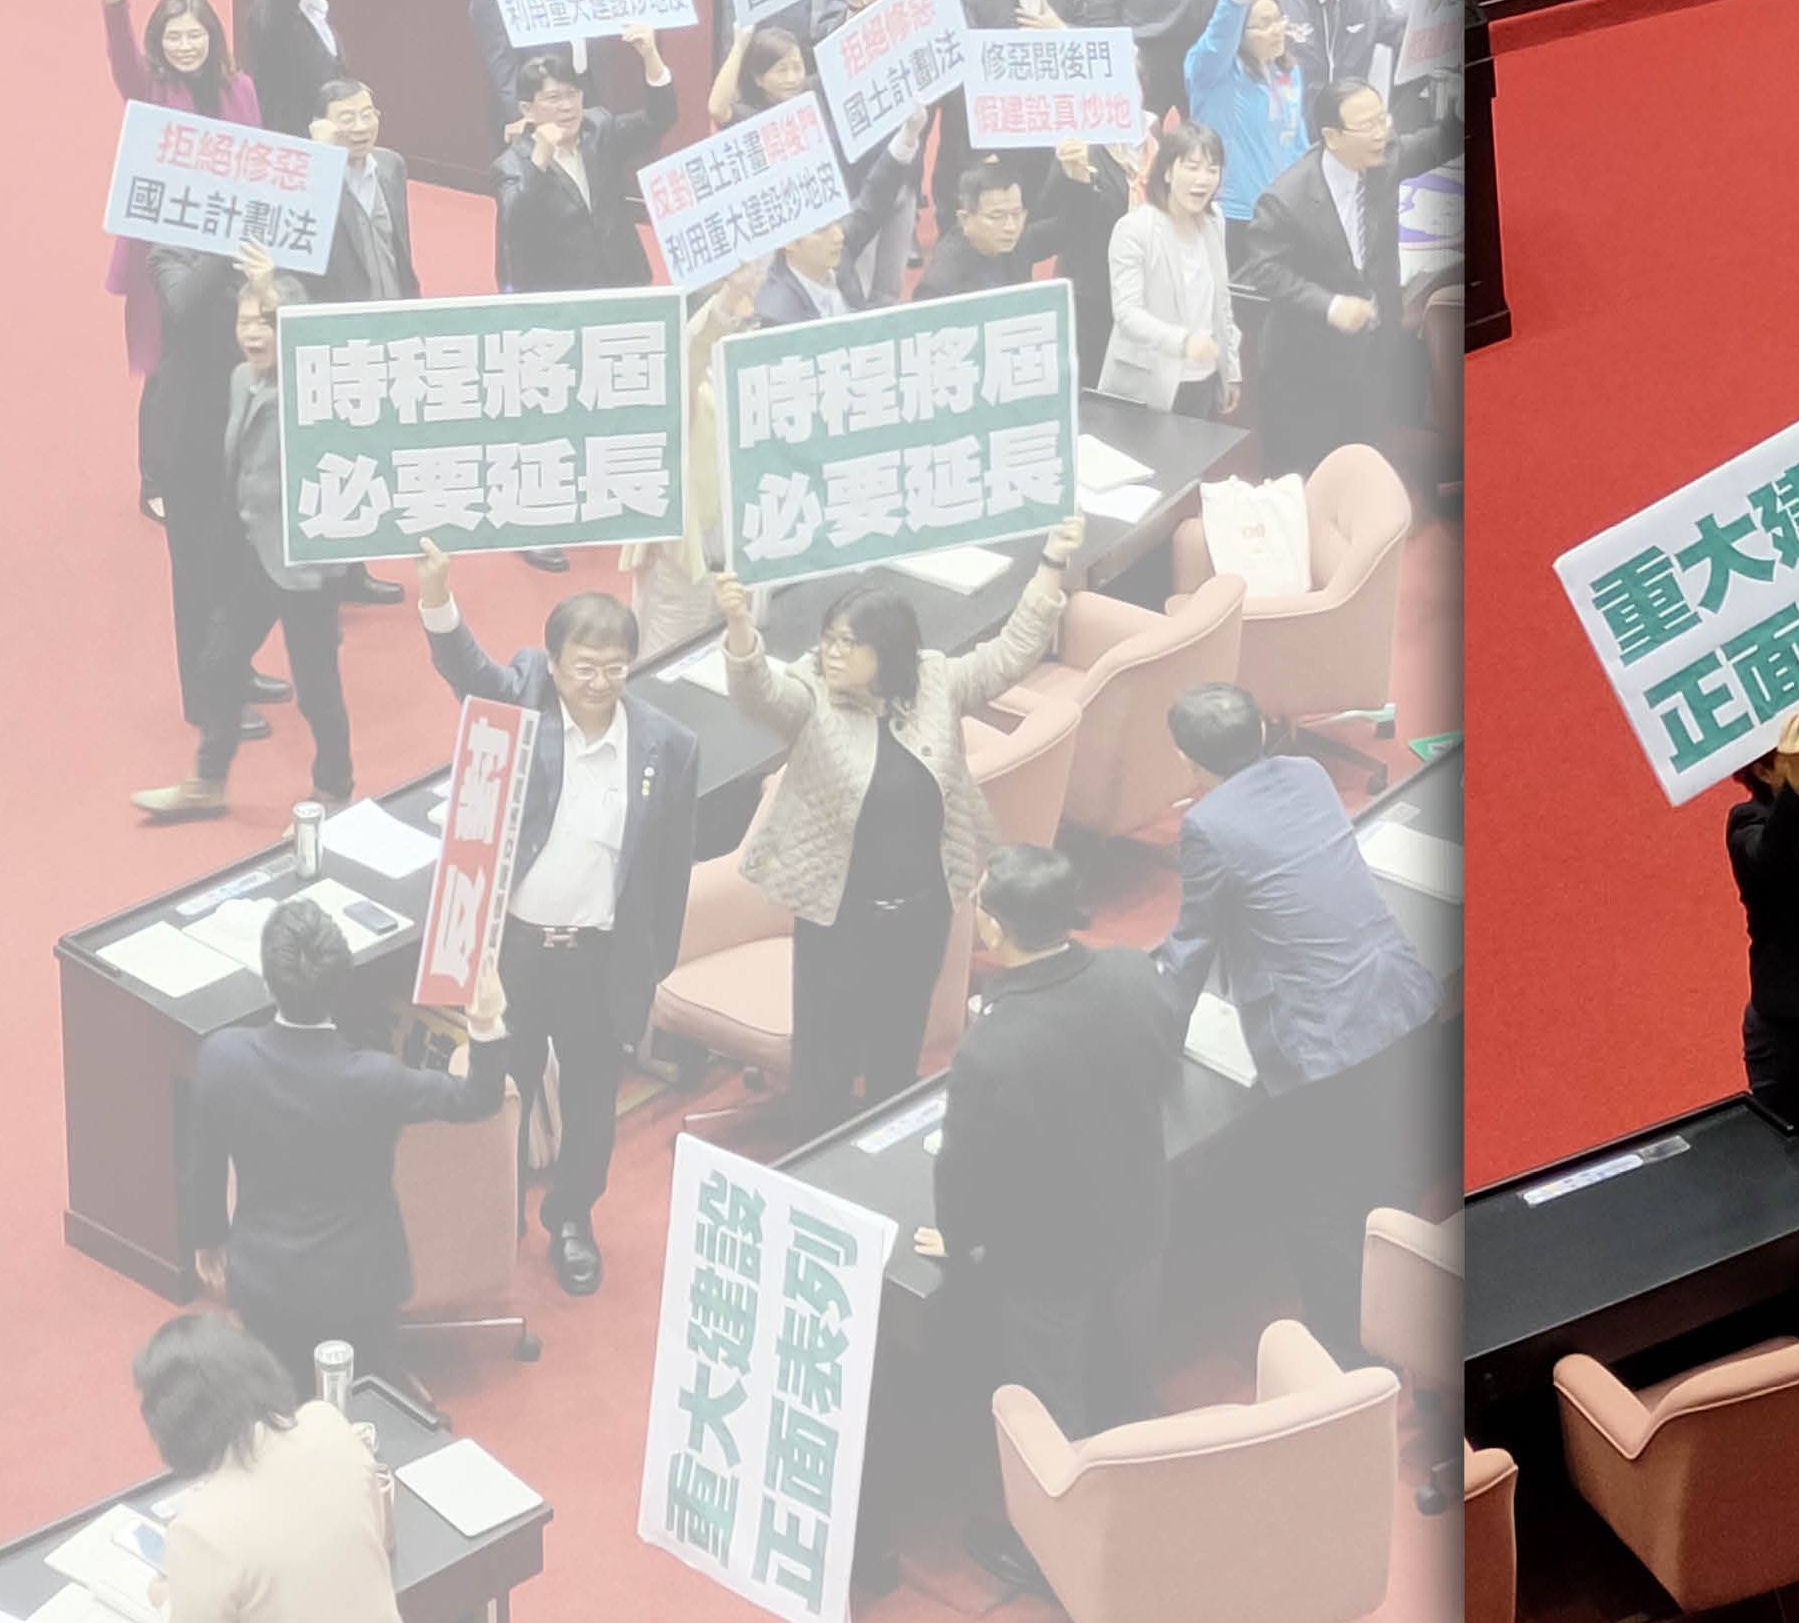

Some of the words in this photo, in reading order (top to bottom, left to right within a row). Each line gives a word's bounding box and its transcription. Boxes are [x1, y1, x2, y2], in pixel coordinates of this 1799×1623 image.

[843, 30, 966, 141] 國土計劃法
[973, 95, 1133, 134] 假建設真炒地
[980, 41, 1113, 83] 修惡開後門
[157, 122, 311, 192] 拒絕修惡
[125, 176, 317, 255] 國土計劃法
[294, 322, 667, 428] 時程將屆
[739, 311, 1059, 448] 時程將屆
[298, 433, 670, 539] 必要延長
[743, 422, 1063, 562] 必要延長
[666, 1168, 766, 1568] 重大建設
[751, 1206, 859, 1615] 正面表列
